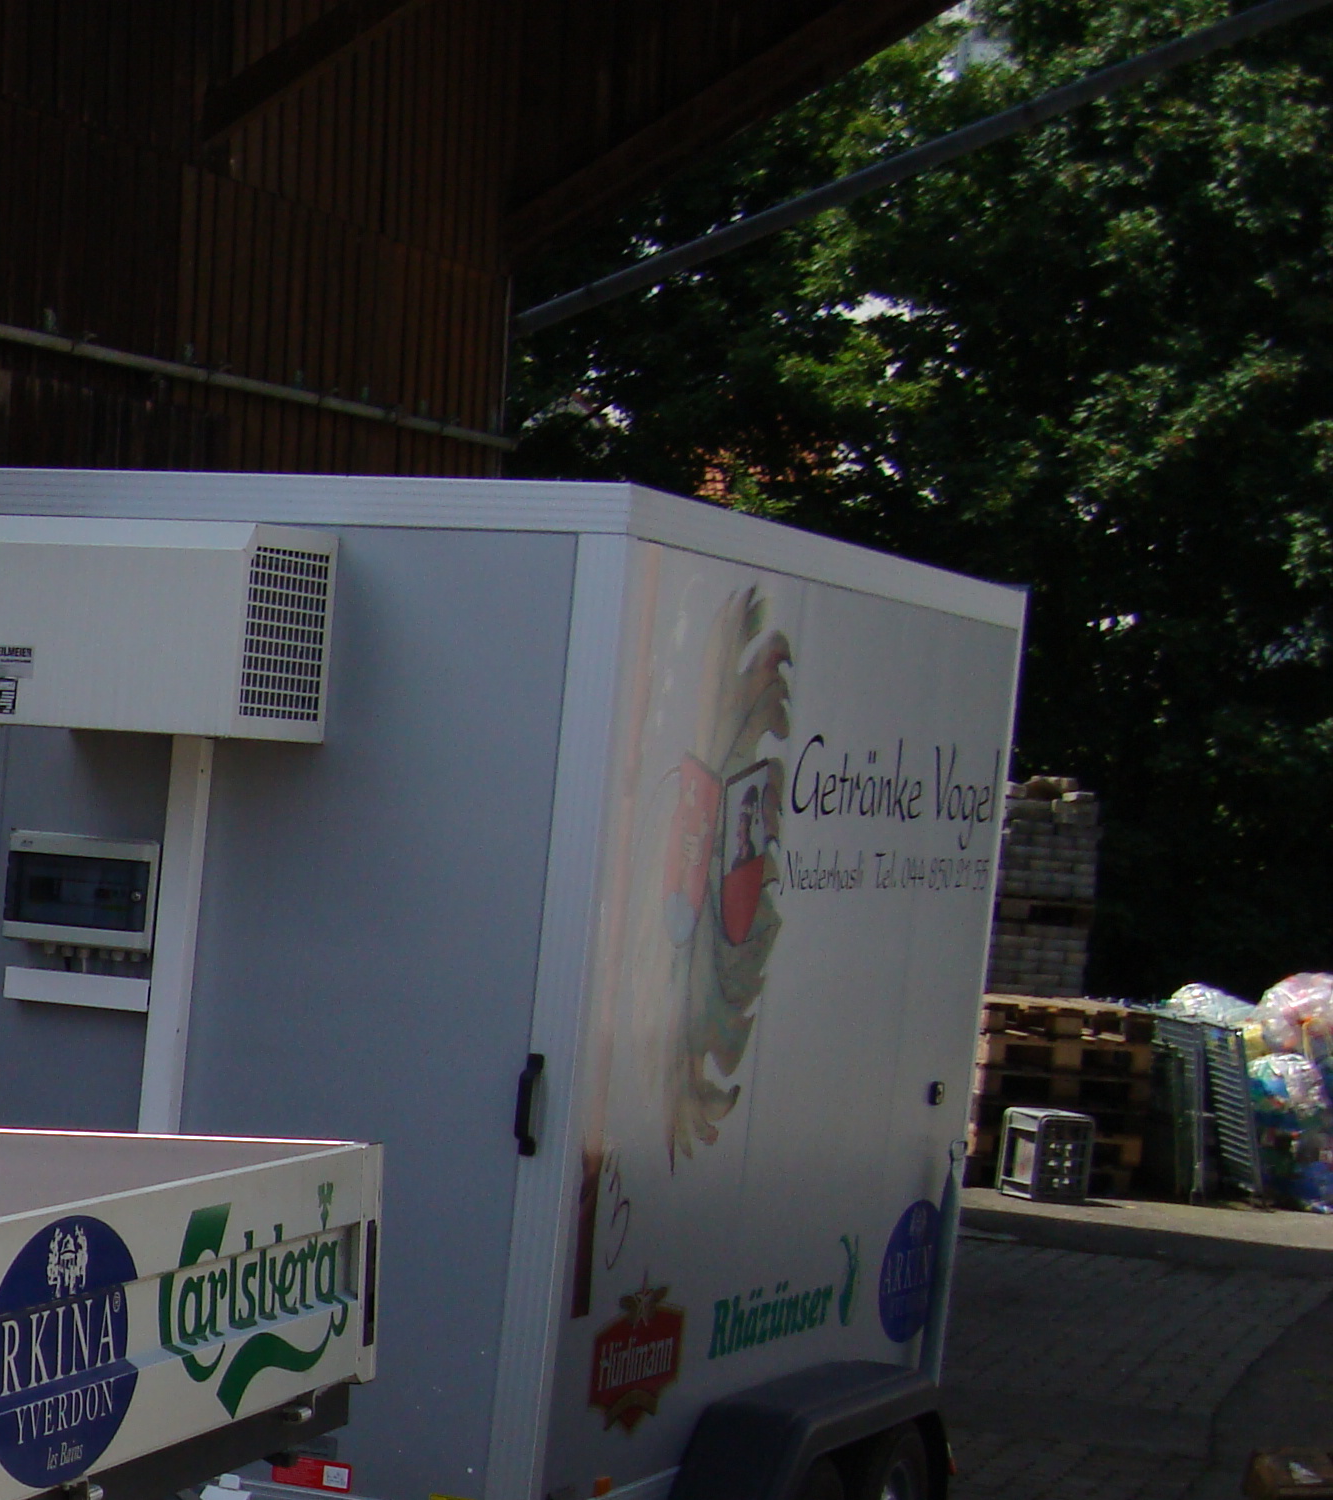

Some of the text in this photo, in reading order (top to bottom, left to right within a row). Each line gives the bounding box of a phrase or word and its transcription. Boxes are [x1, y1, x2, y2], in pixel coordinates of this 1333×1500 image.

[791, 734, 1001, 850] Getränke Vogel
[158, 1201, 349, 1383] Carlsberg
[707, 1280, 834, 1360] Rhäzünser
[597, 1336, 674, 1391] Hürlimann
[14, 1377, 116, 1444] YVERDON
[46, 1448, 59, 1471] les
